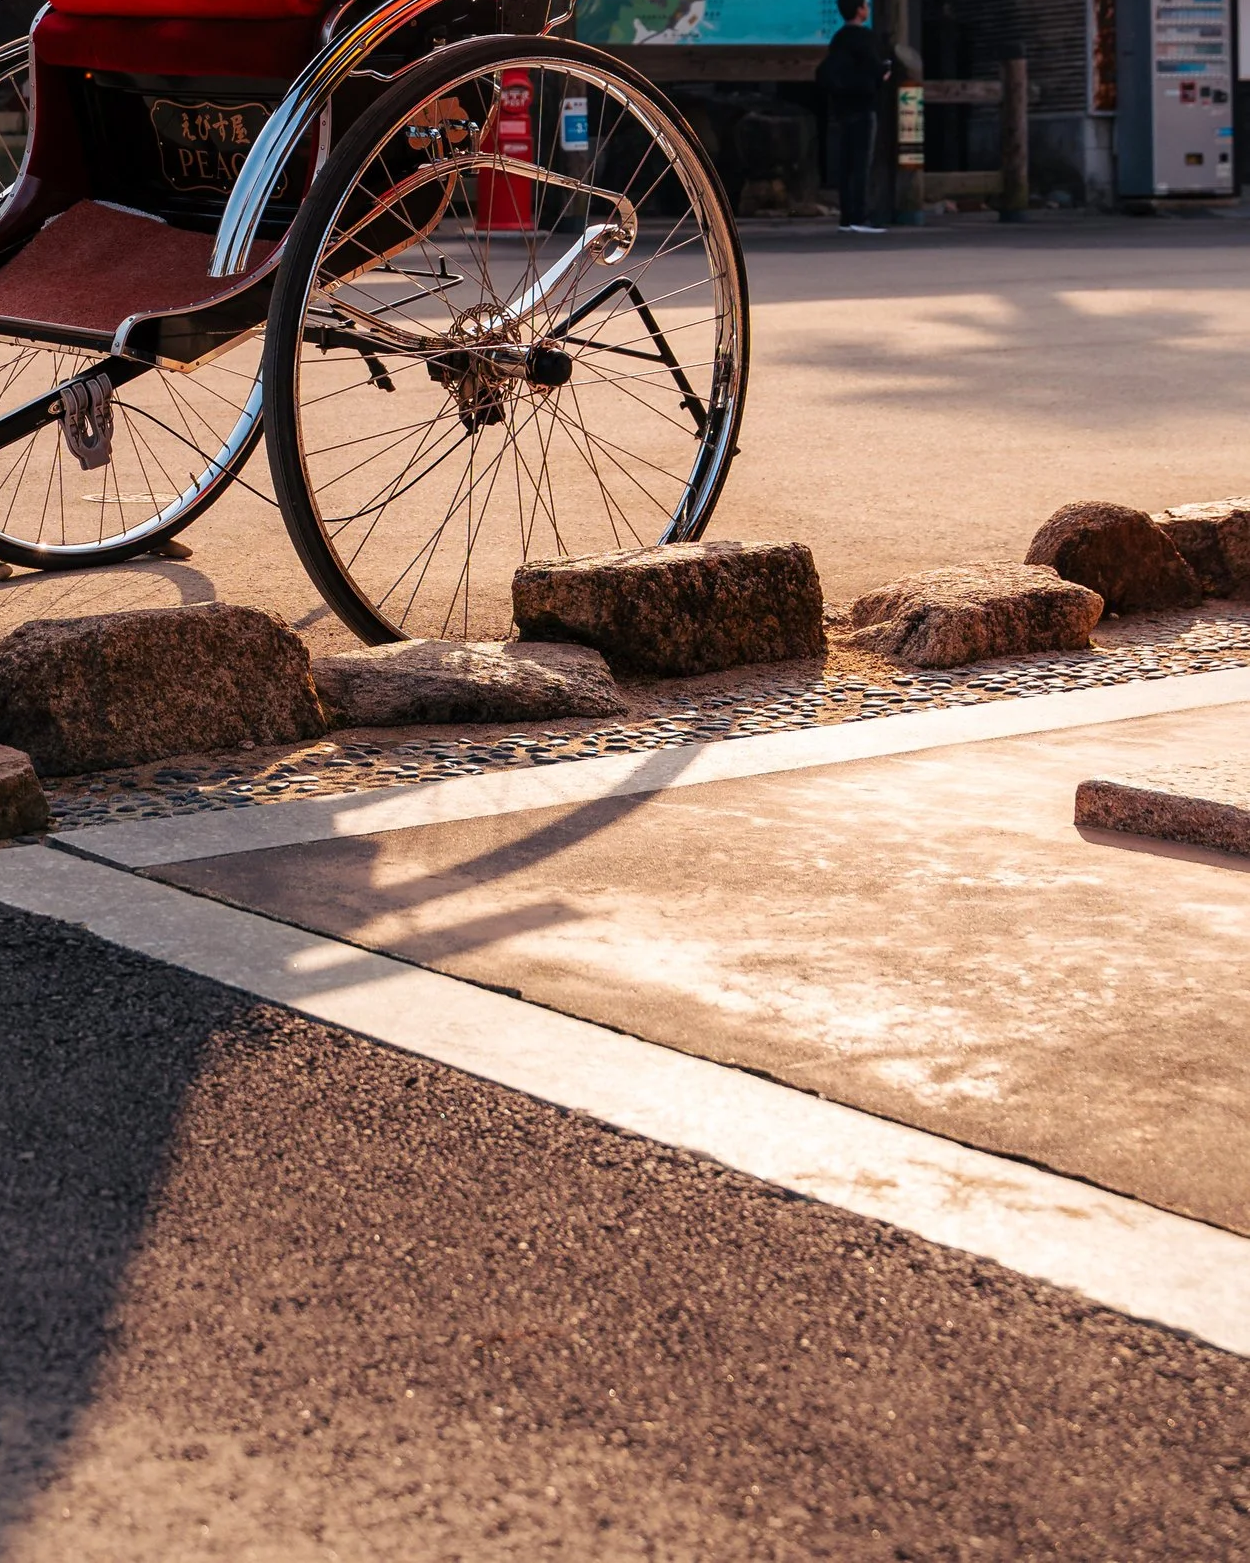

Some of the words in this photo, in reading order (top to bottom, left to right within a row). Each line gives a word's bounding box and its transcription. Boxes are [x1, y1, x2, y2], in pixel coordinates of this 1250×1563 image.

[181, 112, 250, 144] えびす屋
[178, 148, 247, 179] PEAC
